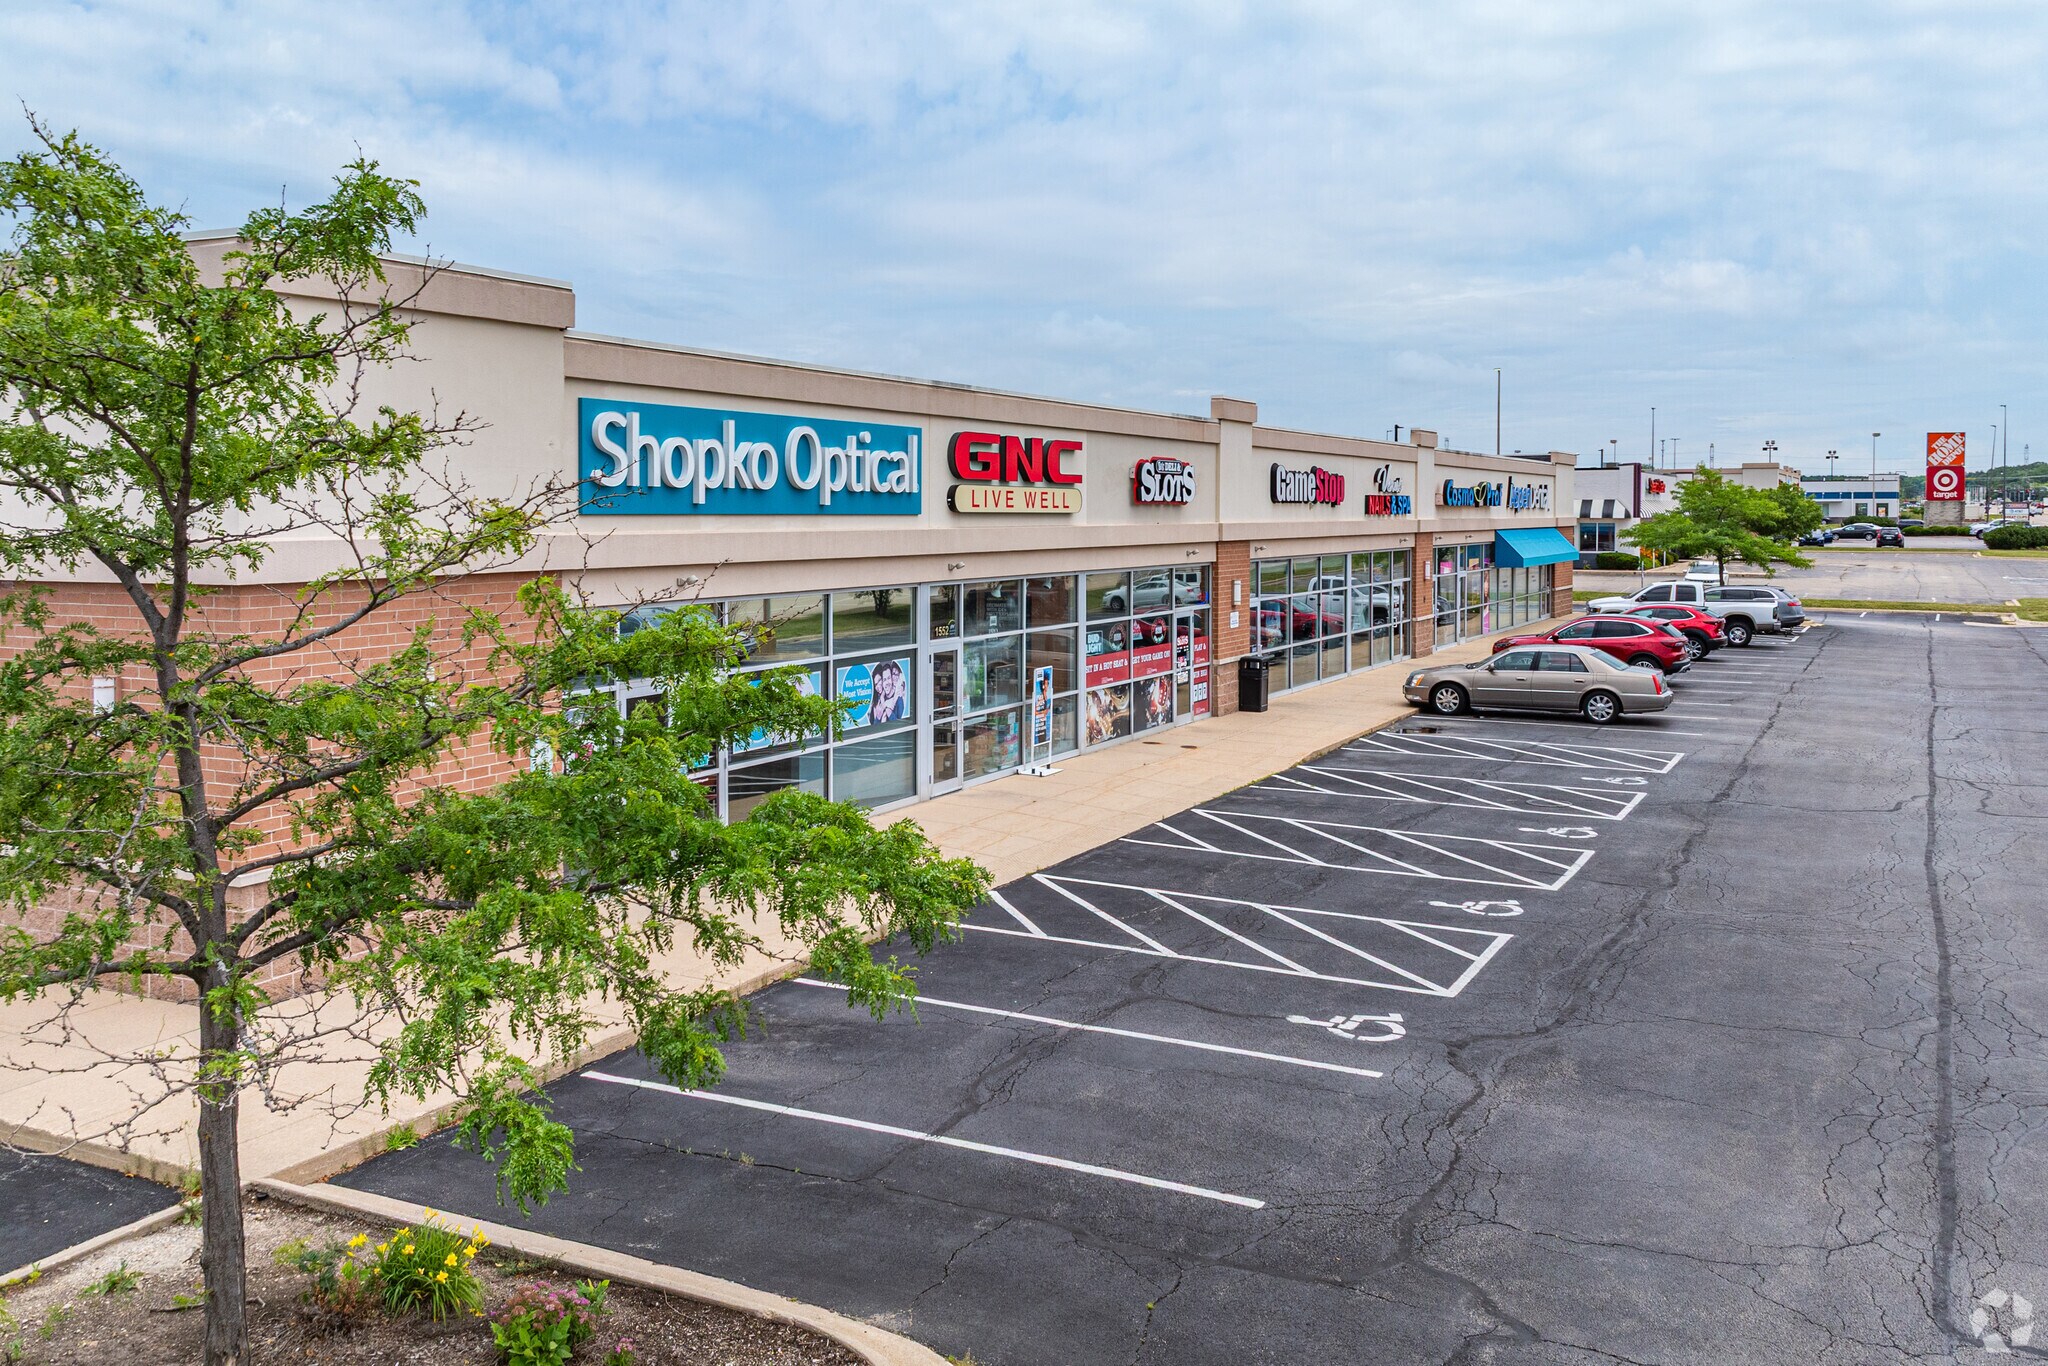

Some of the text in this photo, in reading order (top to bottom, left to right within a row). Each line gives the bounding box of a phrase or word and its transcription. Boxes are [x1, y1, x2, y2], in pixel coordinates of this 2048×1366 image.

[1928, 433, 1965, 466] HOME
[1931, 435, 1948, 450] THE
[591, 411, 919, 505] Shopko Optical
[949, 431, 1083, 484] GNC
[1942, 444, 1965, 466] DEPOT
[1141, 462, 1196, 503] SLOTS
[1273, 463, 1345, 505] GameStop
[1445, 479, 1475, 506] Cosmo
[971, 489, 1070, 509] LIVE WELL
[1368, 495, 1411, 515] NAILS & SPA
[1933, 491, 1958, 499] target
[934, 625, 950, 637] 1552
[1087, 633, 1100, 644] BUD
[1099, 662, 1103, 671] A
[844, 678, 870, 688] We Accept
[856, 688, 872, 696] Vision
